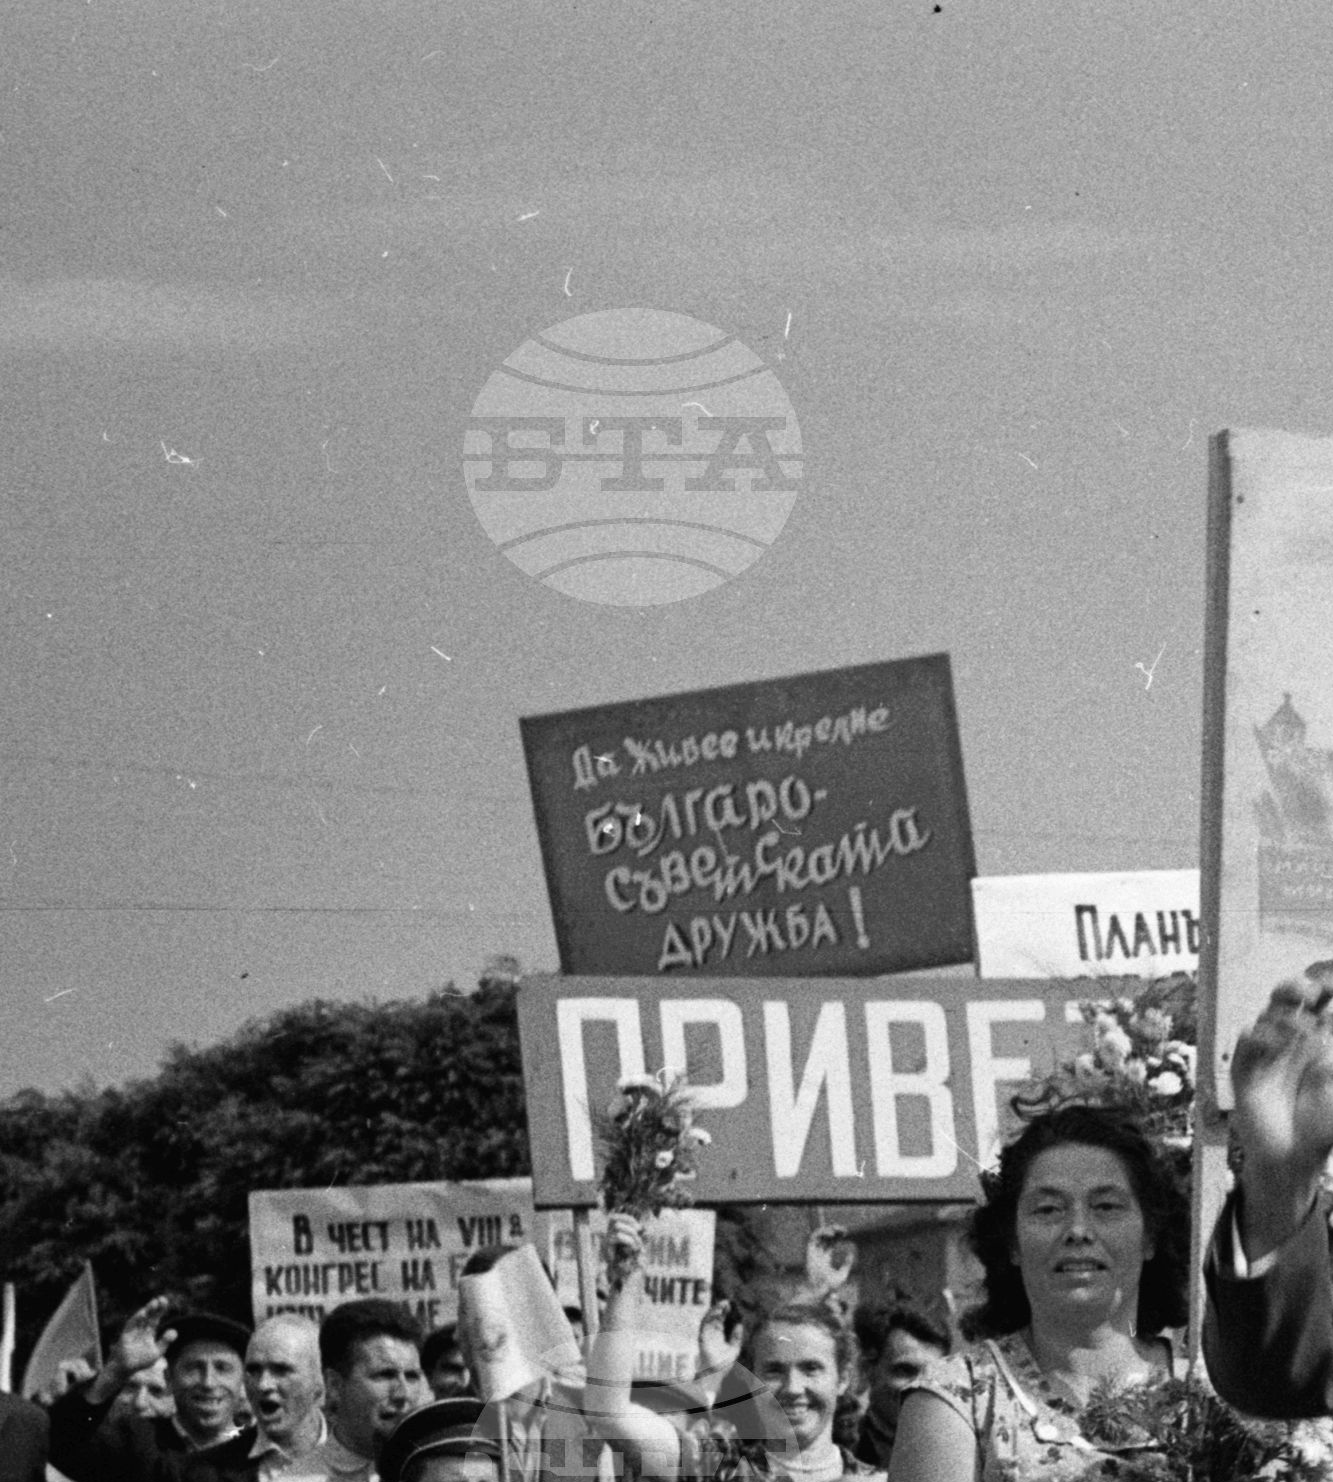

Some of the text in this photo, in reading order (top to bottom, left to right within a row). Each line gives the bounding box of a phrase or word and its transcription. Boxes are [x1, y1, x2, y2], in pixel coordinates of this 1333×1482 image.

[572, 744, 621, 791] Да
[556, 996, 1086, 1180] ПРИВЕ
[293, 1214, 313, 1255] В
[327, 1219, 389, 1253] ЧЕСТ
[406, 1218, 441, 1249] НА
[264, 1261, 386, 1296] КОНГРЕС
[401, 1258, 436, 1292] НА
